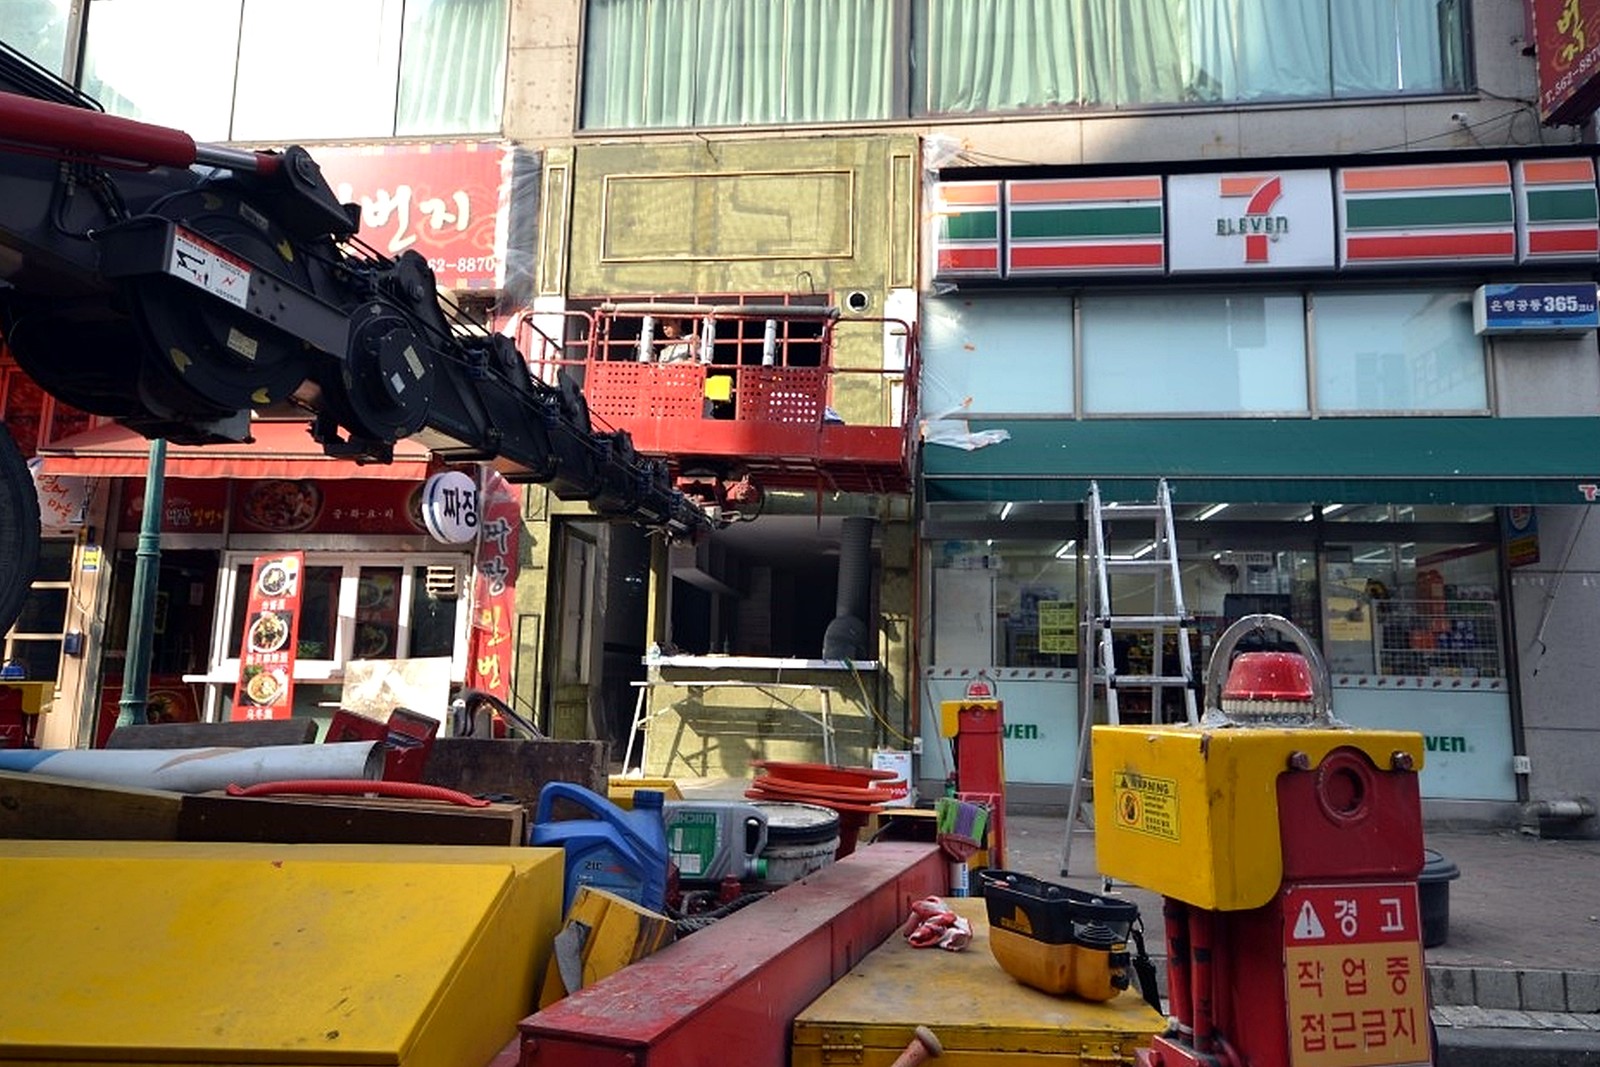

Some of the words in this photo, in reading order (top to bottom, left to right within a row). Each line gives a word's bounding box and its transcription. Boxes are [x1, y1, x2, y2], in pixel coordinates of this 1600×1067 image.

[338, 183, 470, 252] 번지
[442, 486, 478, 528] 짜장
[1300, 1007, 1416, 1053] 접근금지
